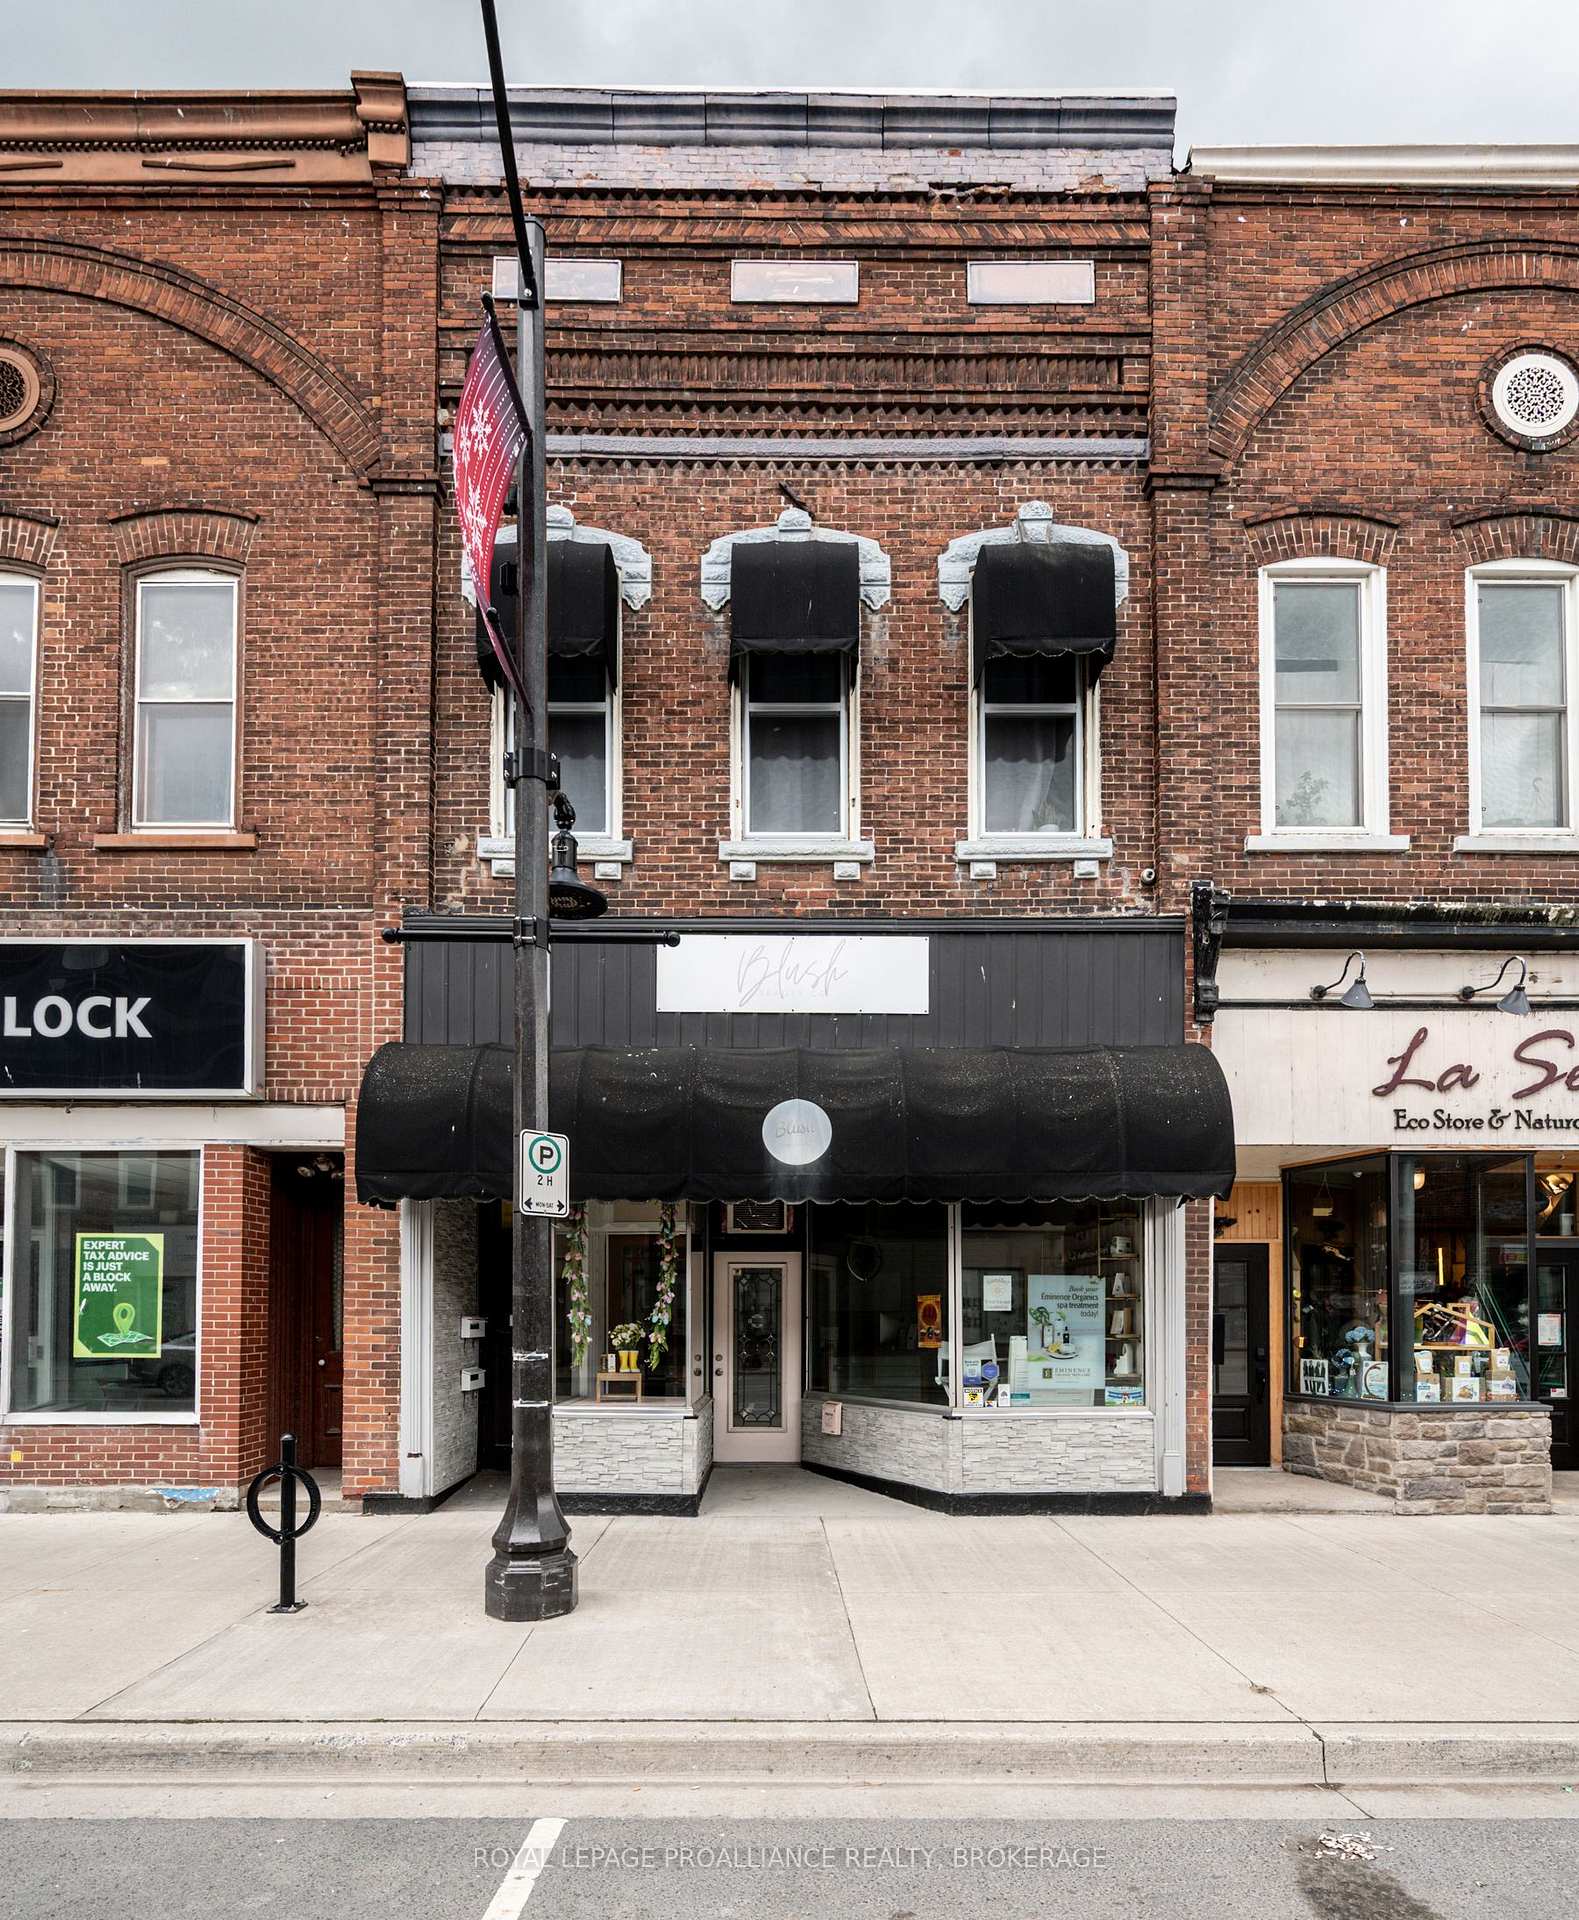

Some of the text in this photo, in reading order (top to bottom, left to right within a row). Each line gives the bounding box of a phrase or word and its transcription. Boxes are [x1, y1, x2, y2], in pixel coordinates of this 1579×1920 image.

[737, 938, 848, 1007] Blush
[1372, 1026, 1480, 1097] La
[1393, 1108, 1430, 1130] Eco
[1433, 1108, 1485, 1130] Store
[1488, 1109, 1511, 1130] &
[539, 1145, 554, 1165] P
[537, 1174, 553, 1186] 2 H
[83, 1240, 126, 1250] EXPERT
[83, 1251, 150, 1261] TAX ADVICE
[83, 1262, 123, 1271] IS JUST
[82, 1272, 132, 1282] A BLOCK
[82, 1283, 118, 1292] AWAY.
